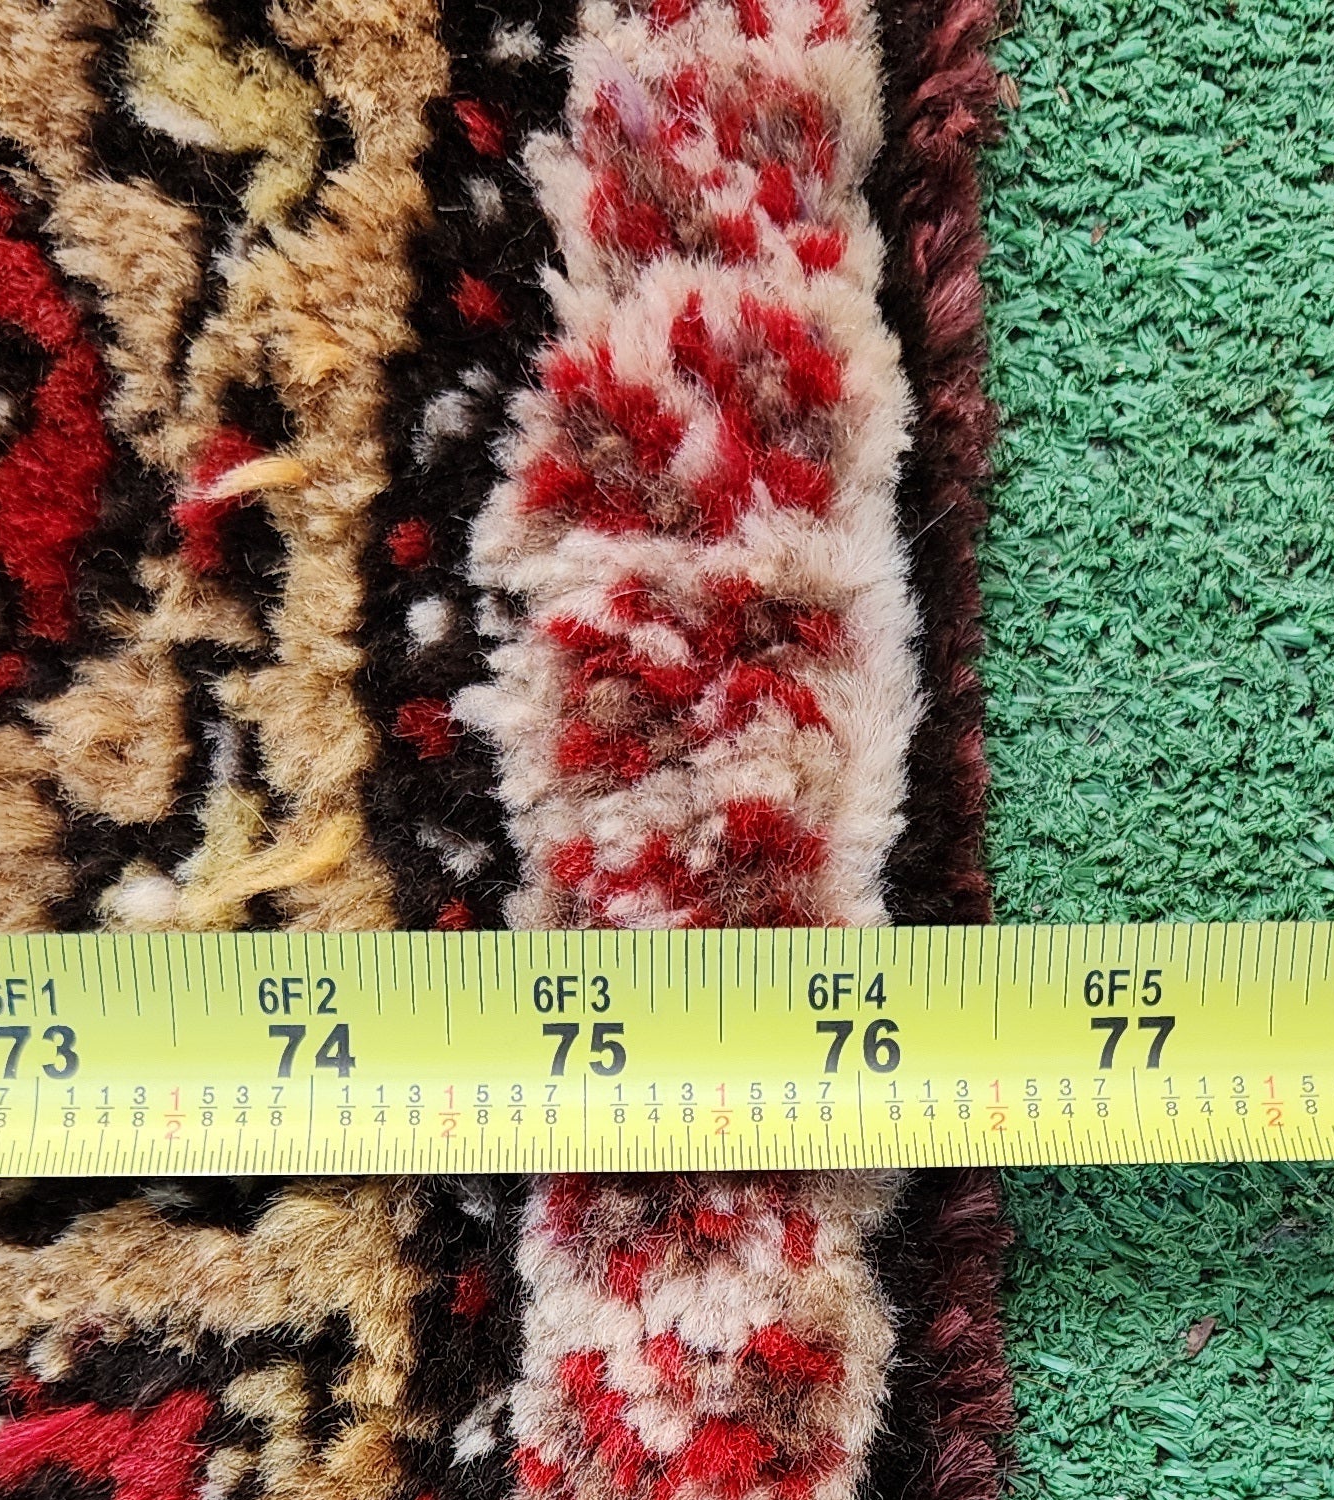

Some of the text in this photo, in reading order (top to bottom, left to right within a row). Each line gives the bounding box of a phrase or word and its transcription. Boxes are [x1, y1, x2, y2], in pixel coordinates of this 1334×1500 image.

[269, 1024, 355, 1081] 74
[543, 1023, 626, 1079] 75
[816, 1019, 900, 1076] 76
[1091, 1016, 1175, 1068] 77
